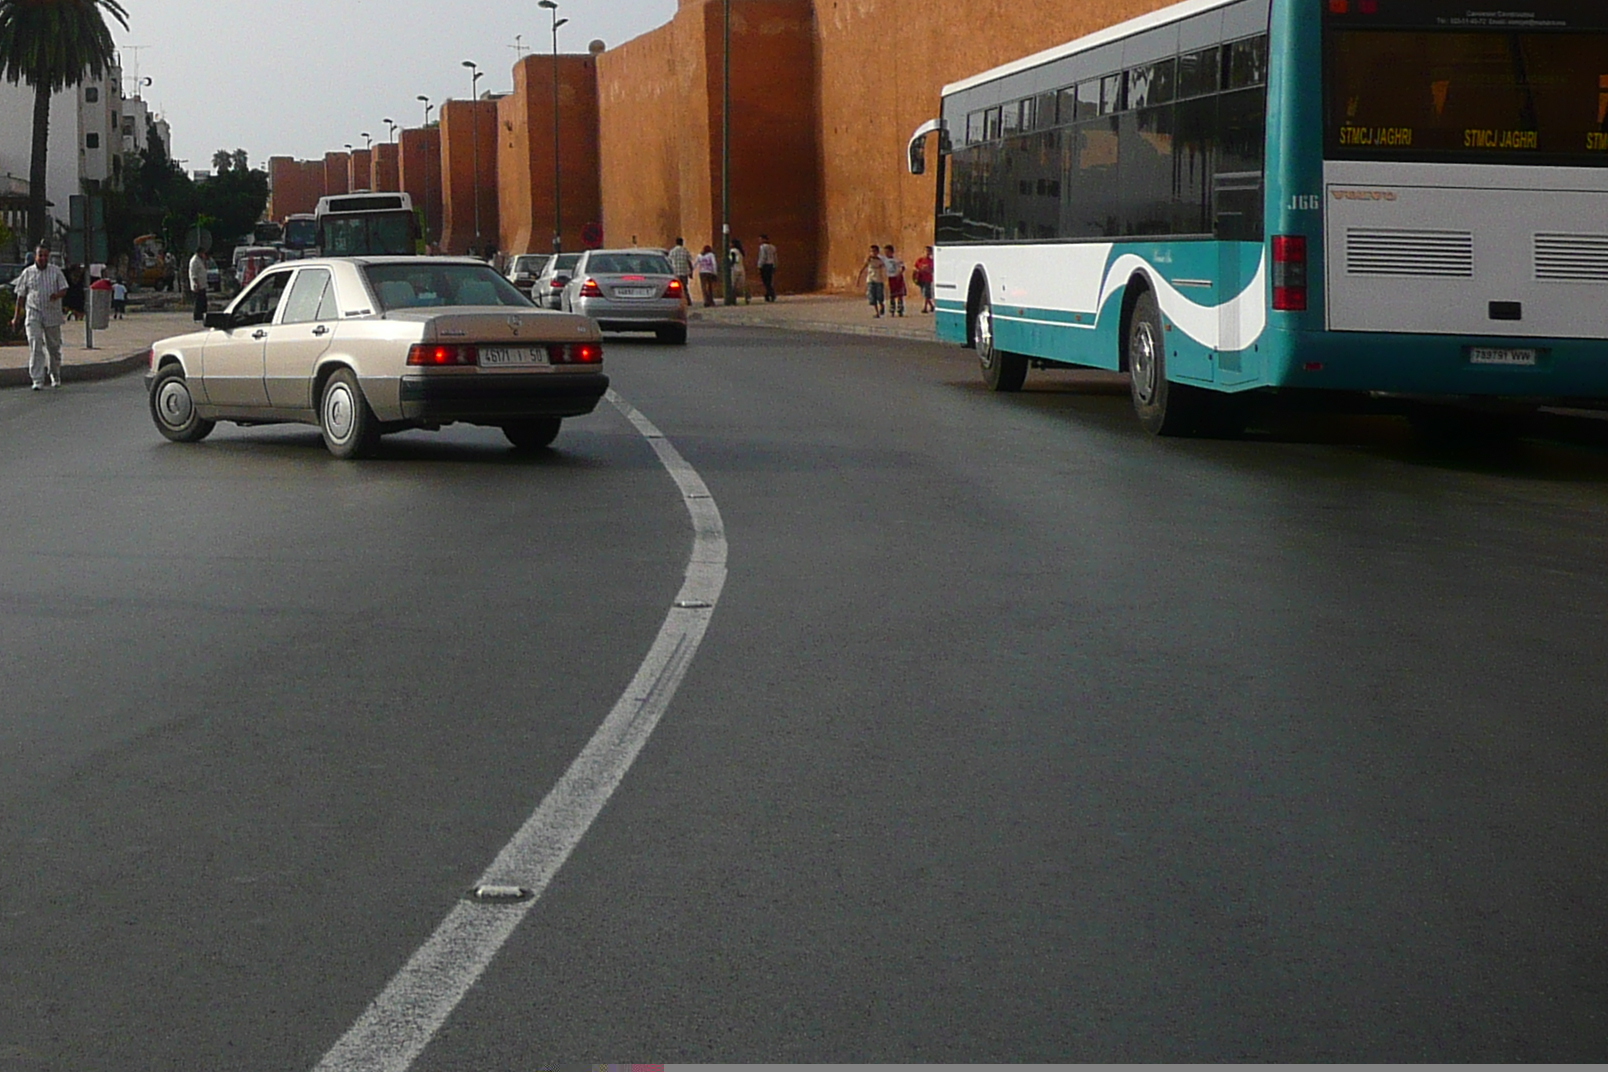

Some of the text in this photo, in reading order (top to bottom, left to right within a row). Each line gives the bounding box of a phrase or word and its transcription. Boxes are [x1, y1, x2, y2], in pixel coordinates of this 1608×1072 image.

[1339, 126, 1412, 145] STMCJ JAGHRI
[1464, 129, 1537, 148] STMCJ JAGHRI
[1287, 194, 1320, 210] J66
[1330, 190, 1397, 201] VOLVO
[485, 348, 510, 362] 46171
[529, 348, 543, 362] 50
[1511, 351, 1531, 361] WW
